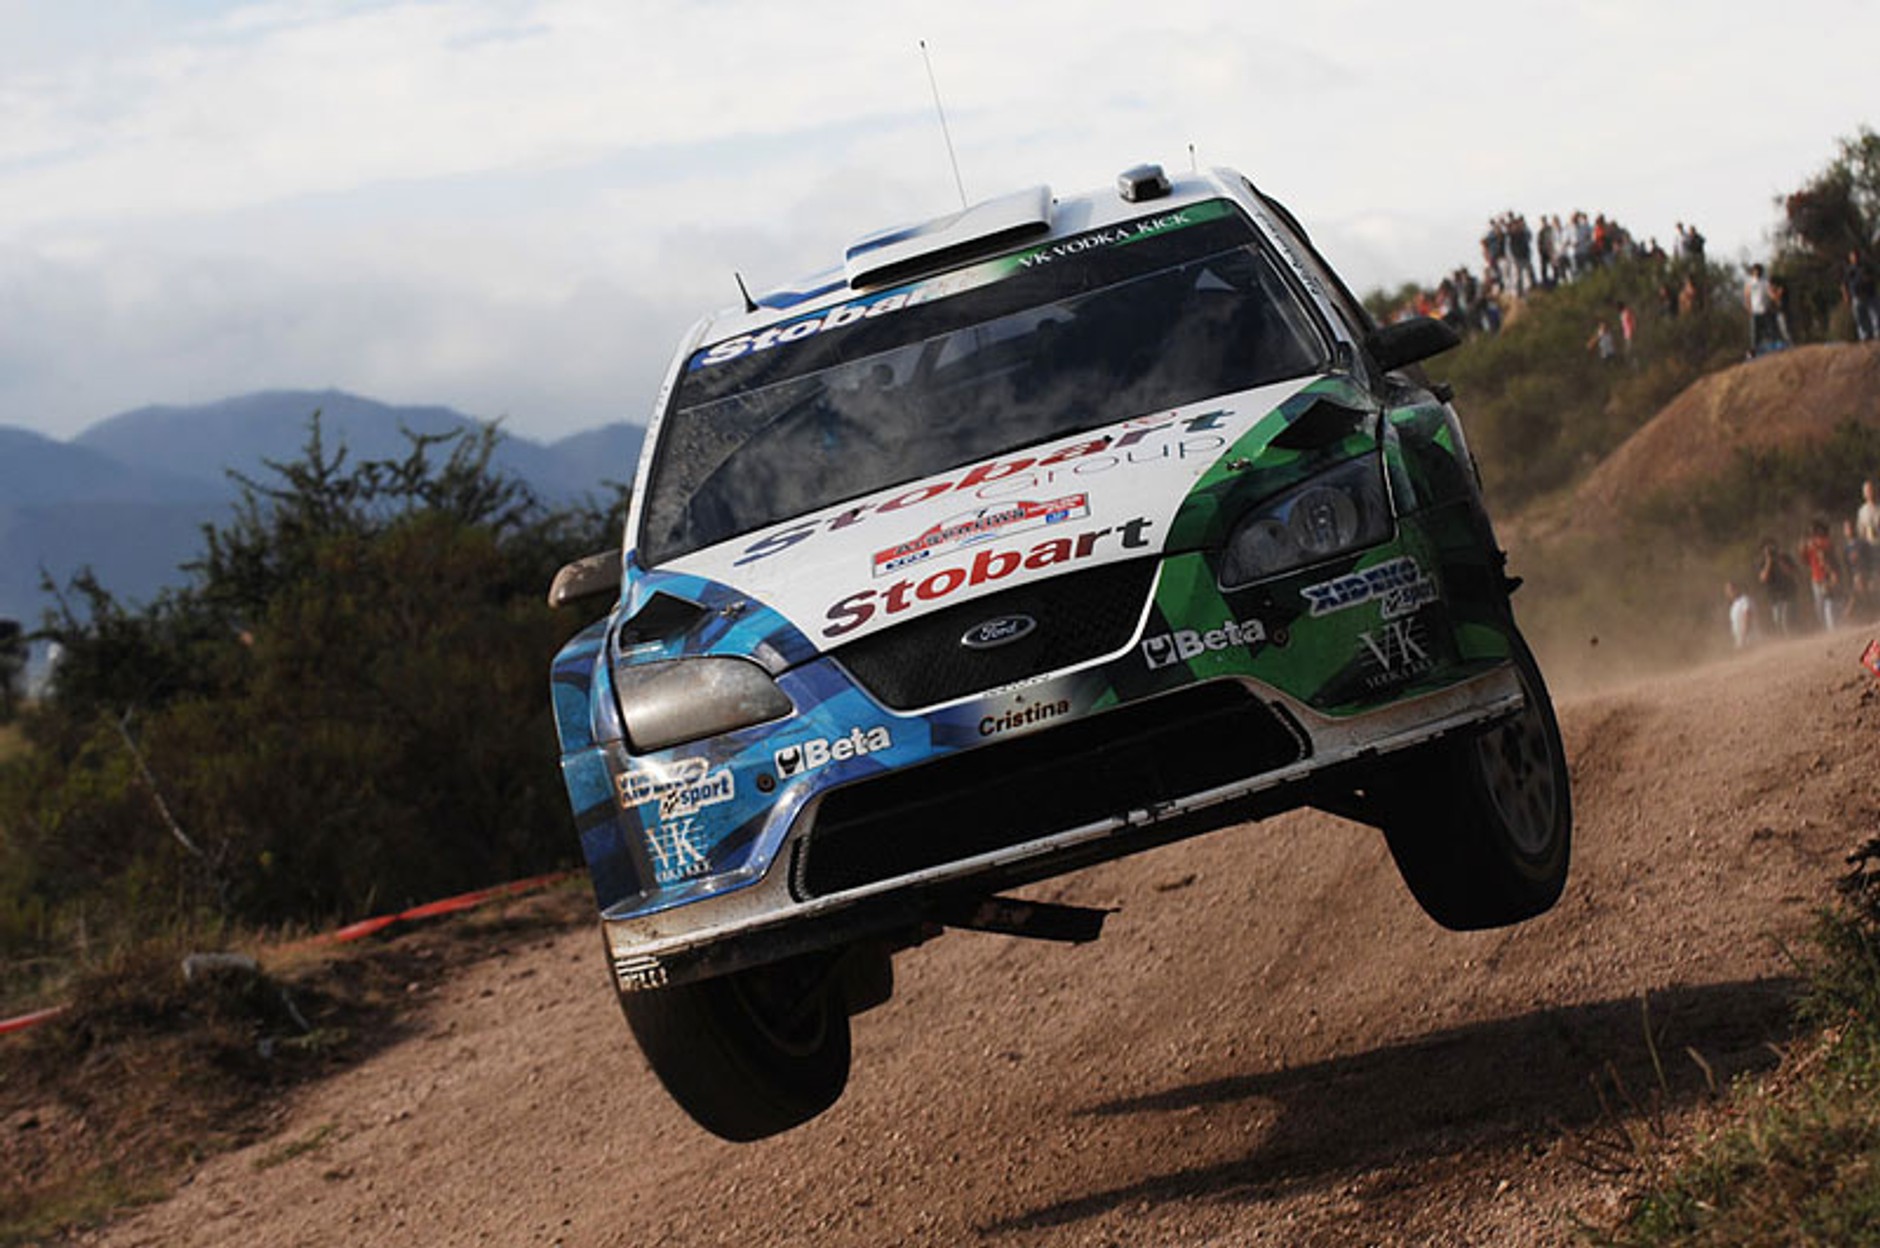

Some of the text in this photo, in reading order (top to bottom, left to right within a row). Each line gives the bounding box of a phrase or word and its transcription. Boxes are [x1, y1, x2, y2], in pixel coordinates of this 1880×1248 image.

[1018, 213, 1191, 268] VK VODKA KICK
[732, 409, 1235, 558] Stobart
[822, 516, 1154, 638] Stobart
[980, 620, 1017, 641] Ford
[1174, 618, 1266, 660] Beta
[1358, 617, 1428, 671] VK
[979, 699, 1070, 737] Cristina
[804, 725, 891, 770] Beta
[681, 776, 729, 806] sport
[646, 818, 706, 869] VK
